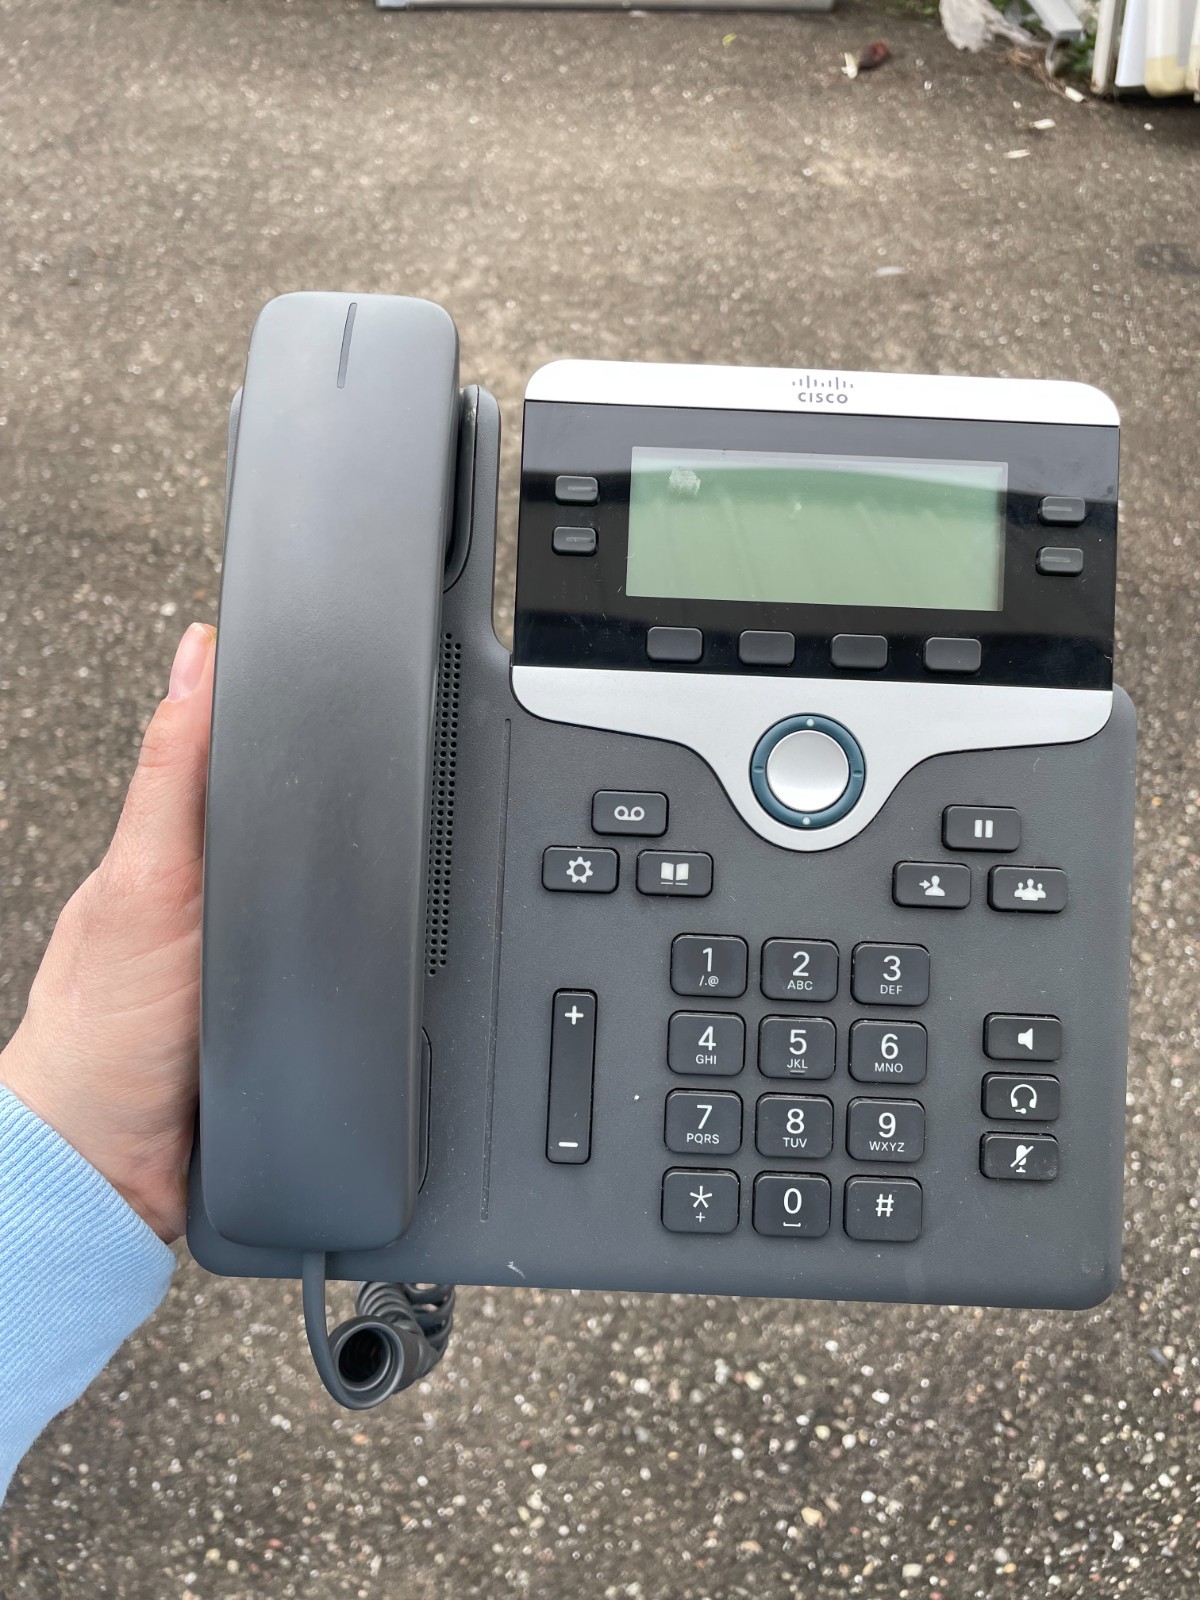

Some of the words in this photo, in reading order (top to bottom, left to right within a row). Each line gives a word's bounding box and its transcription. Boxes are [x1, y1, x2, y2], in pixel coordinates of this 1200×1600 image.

[797, 391, 848, 405] CISCO
[702, 947, 714, 972] 1
[792, 951, 810, 977] 2
[882, 955, 902, 981] 3
[787, 980, 813, 991] ABC
[880, 984, 903, 995] DEF
[698, 1026, 717, 1051] 4
[789, 1029, 807, 1055] 5
[880, 1033, 899, 1060] 6
[695, 1054, 717, 1065] GHI
[786, 1058, 808, 1070] JKL
[874, 1062, 904, 1073] MNO
[696, 1104, 713, 1129] 7
[786, 1108, 805, 1134] 8
[878, 1112, 897, 1138] 9
[686, 1133, 720, 1144] PQRS
[782, 1137, 807, 1148] TUV
[869, 1141, 905, 1153] WXYZ
[783, 1188, 802, 1215] 0
